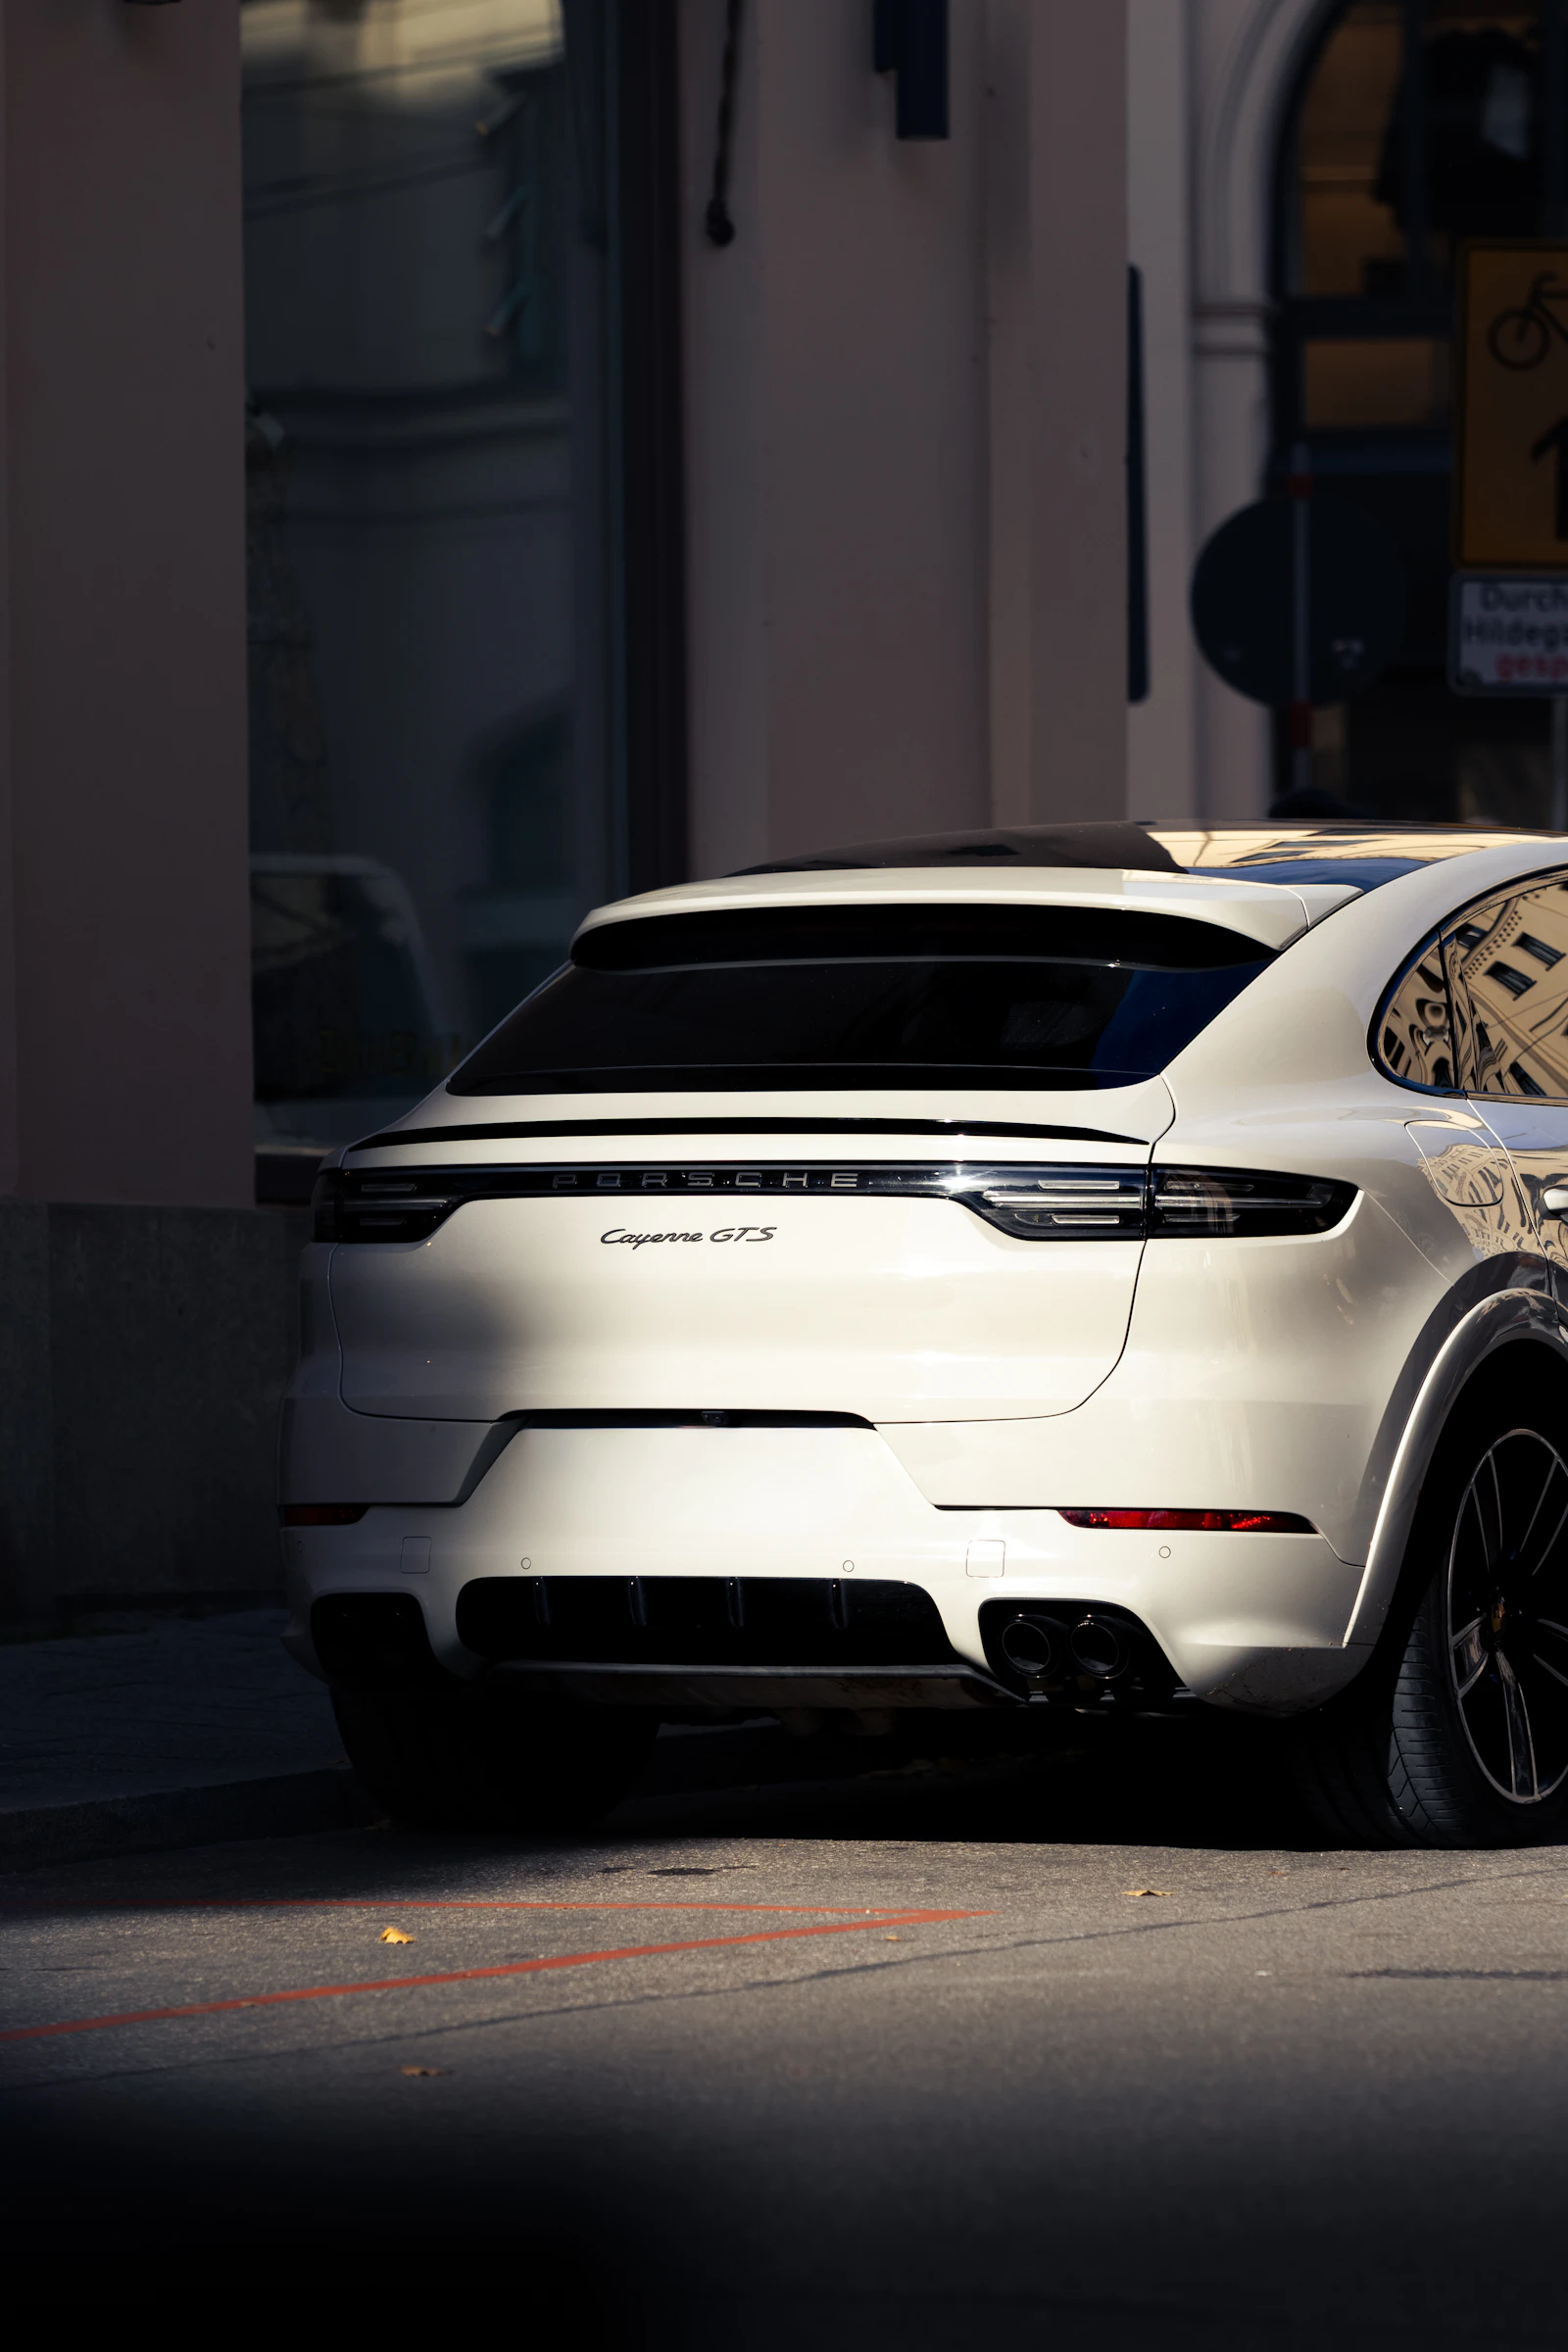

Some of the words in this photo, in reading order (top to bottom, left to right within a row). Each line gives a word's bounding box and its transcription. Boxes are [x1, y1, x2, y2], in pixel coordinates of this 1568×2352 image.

[552, 1171, 859, 1190] PORSCHE
[600, 1228, 704, 1250] Cayenne
[710, 1227, 777, 1243] GTS
